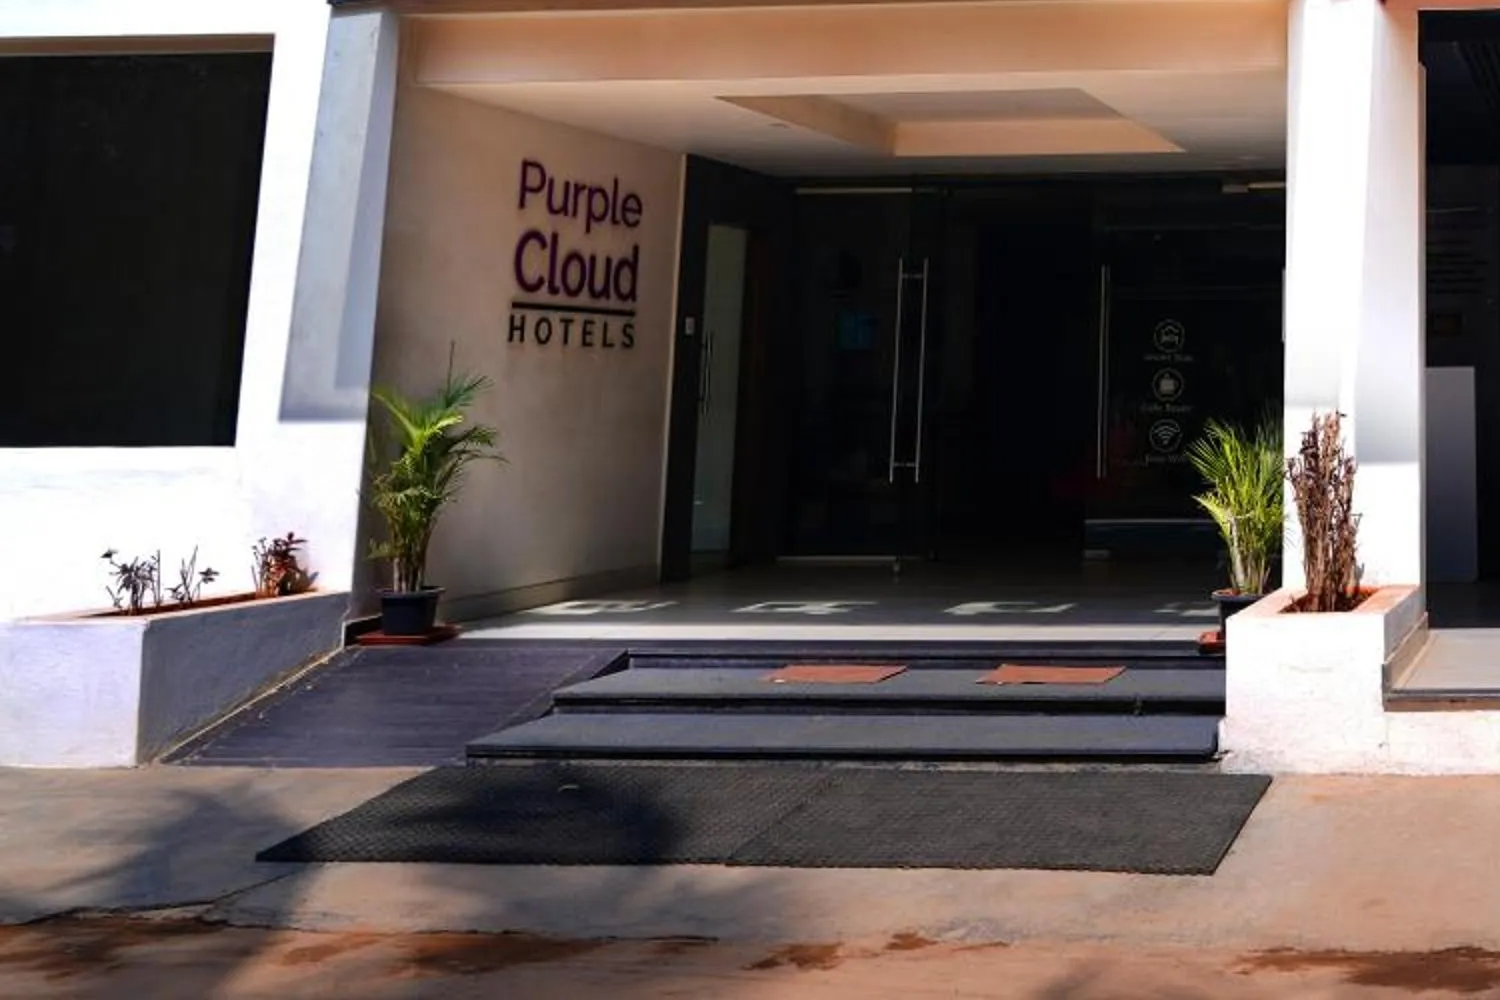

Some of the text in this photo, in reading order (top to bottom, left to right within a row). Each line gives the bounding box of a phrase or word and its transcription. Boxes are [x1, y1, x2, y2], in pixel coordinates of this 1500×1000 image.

[518, 158, 643, 234] Purple
[513, 229, 639, 303] Cloud
[508, 314, 635, 348] HOTELS
